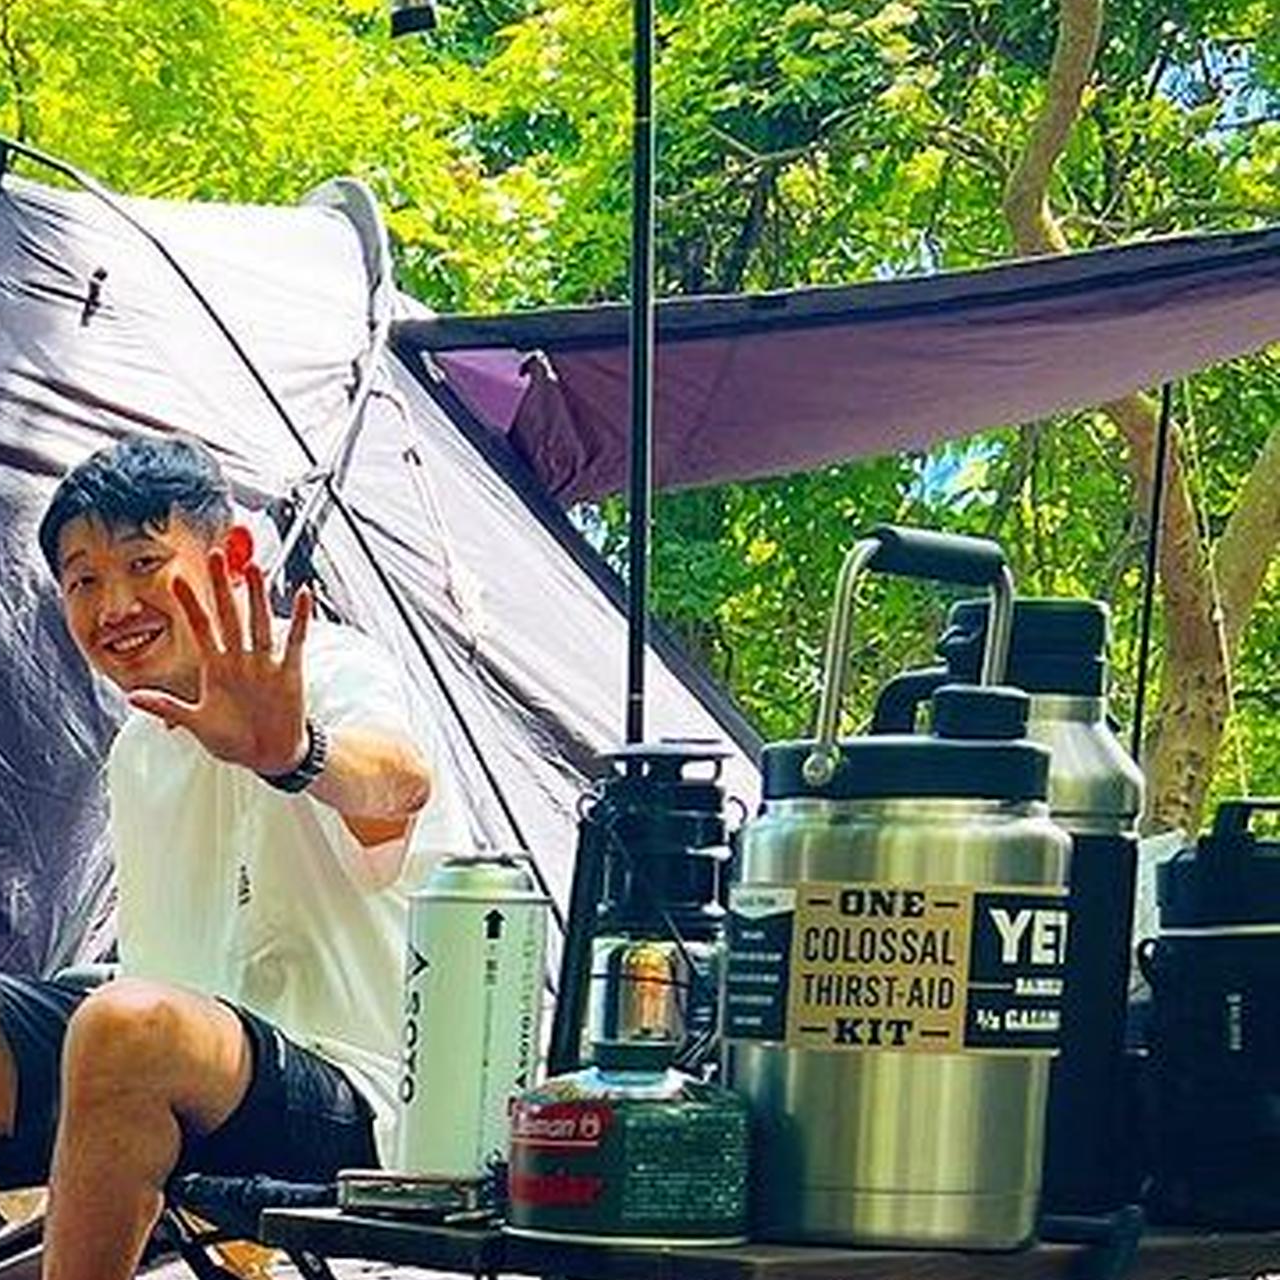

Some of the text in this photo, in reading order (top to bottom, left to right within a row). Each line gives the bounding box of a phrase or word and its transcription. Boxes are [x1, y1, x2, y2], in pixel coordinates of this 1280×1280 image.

[841, 889, 925, 917] ONE
[804, 926, 956, 966] COLOSSAL
[802, 973, 955, 1010] THIRST-AID
[834, 1017, 914, 1046] KIT
